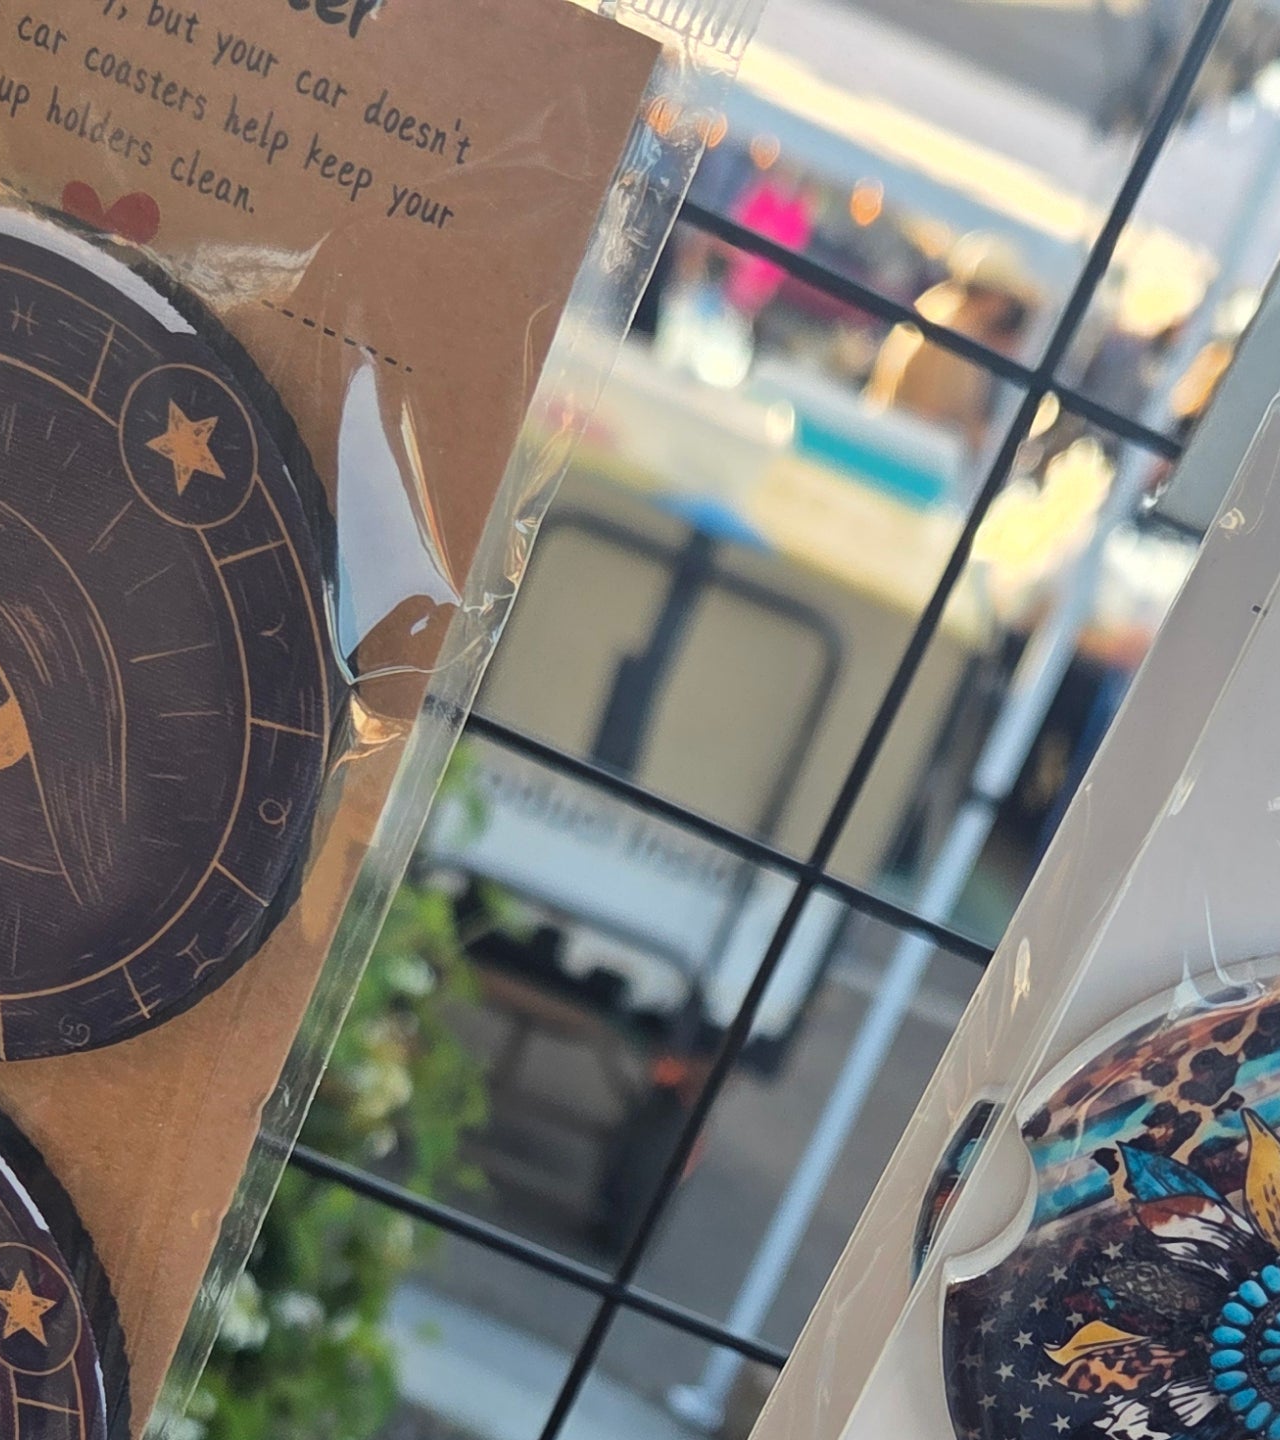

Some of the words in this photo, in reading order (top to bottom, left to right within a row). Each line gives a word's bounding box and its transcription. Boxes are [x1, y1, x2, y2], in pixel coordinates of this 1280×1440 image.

[17, 16, 67, 54] car
[84, 47, 207, 120] coasters
[224, 94, 288, 164] help
[304, 133, 372, 201] keep
[387, 184, 454, 229] your
[46, 87, 151, 167] holders
[170, 150, 255, 214] clean.
[147, 0, 199, 43] but
[213, 31, 278, 77] your
[296, 70, 347, 107] car
[364, 90, 471, 164] doesn't
